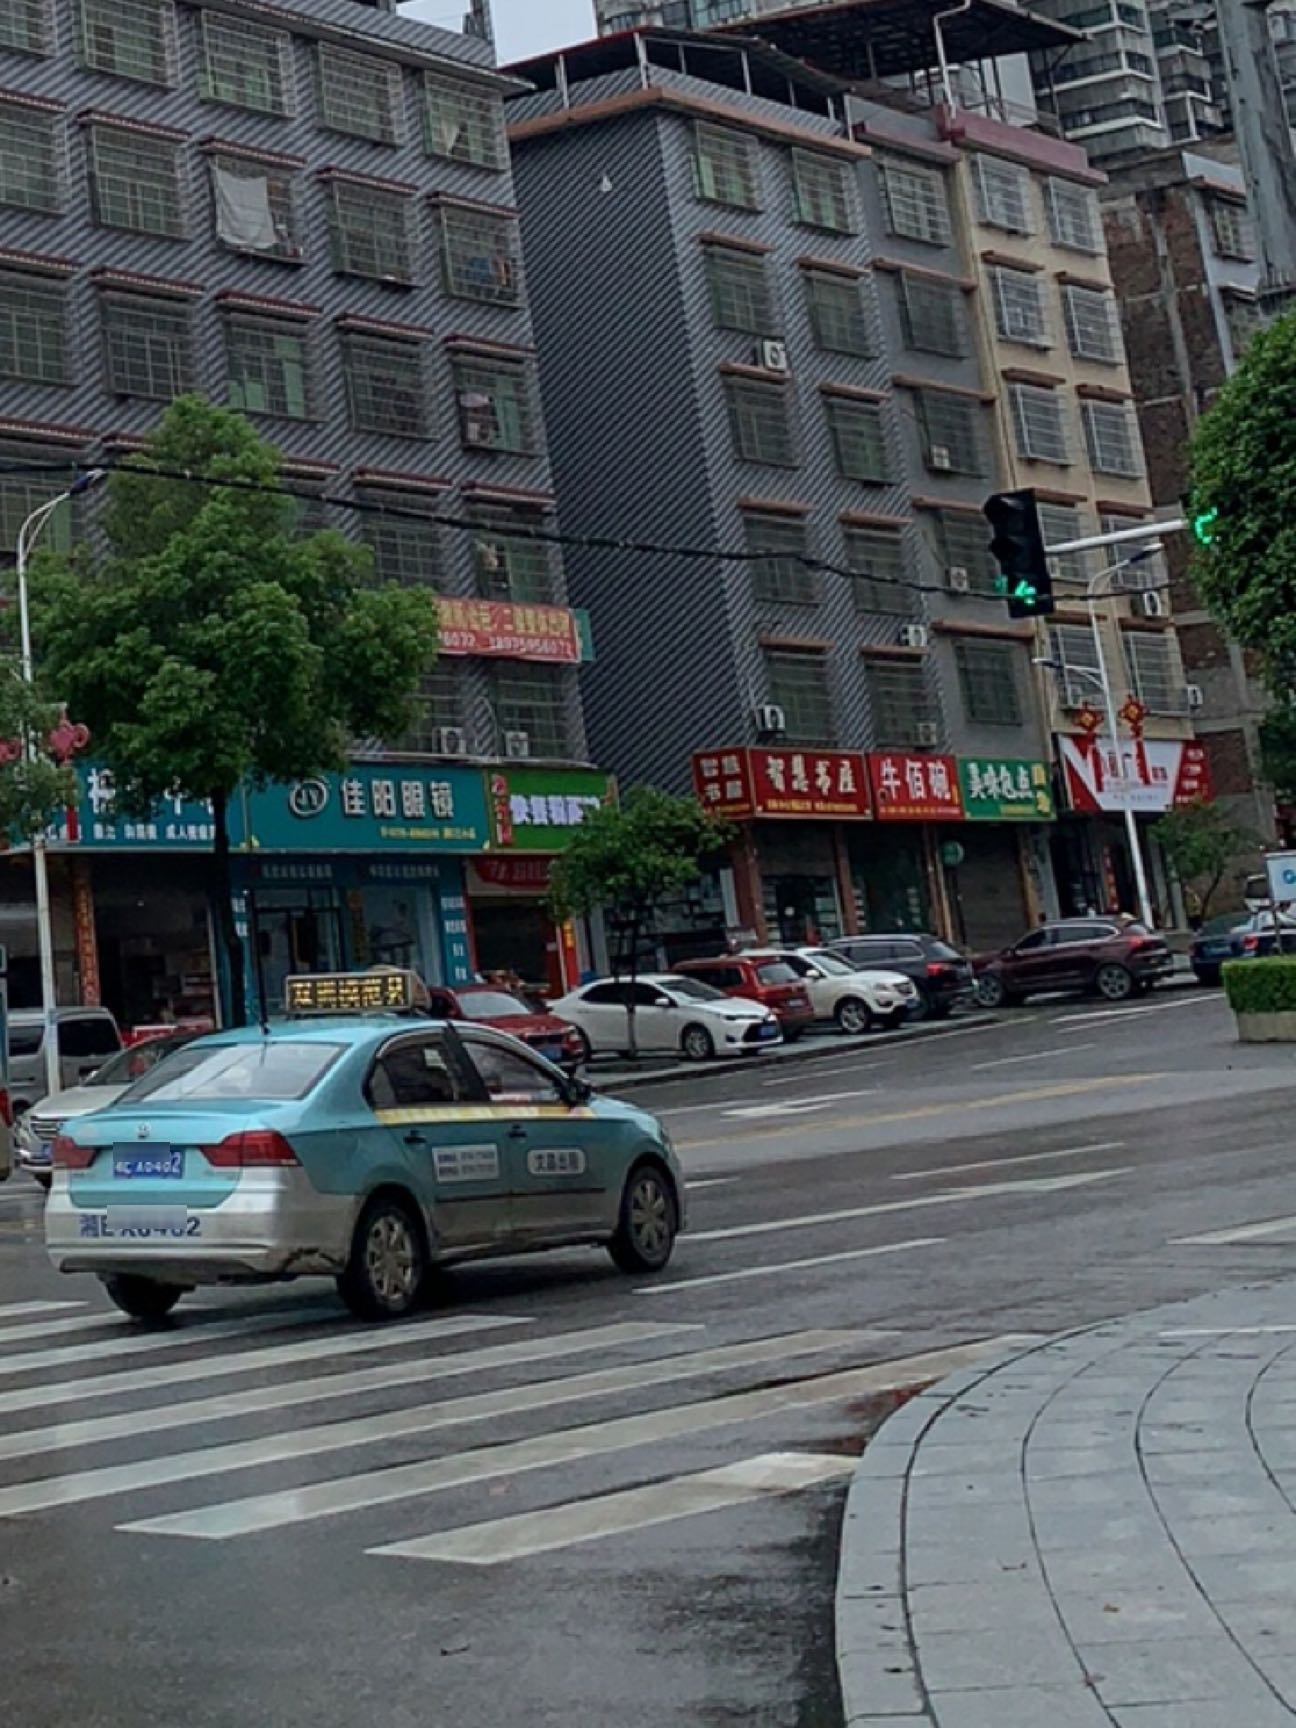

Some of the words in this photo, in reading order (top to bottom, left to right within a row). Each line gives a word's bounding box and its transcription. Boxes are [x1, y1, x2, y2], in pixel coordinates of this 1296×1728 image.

[341, 777, 454, 819] 佳阳眼镜
[880, 757, 952, 800] 牛佰碗
[967, 761, 1035, 800] 美味包点
